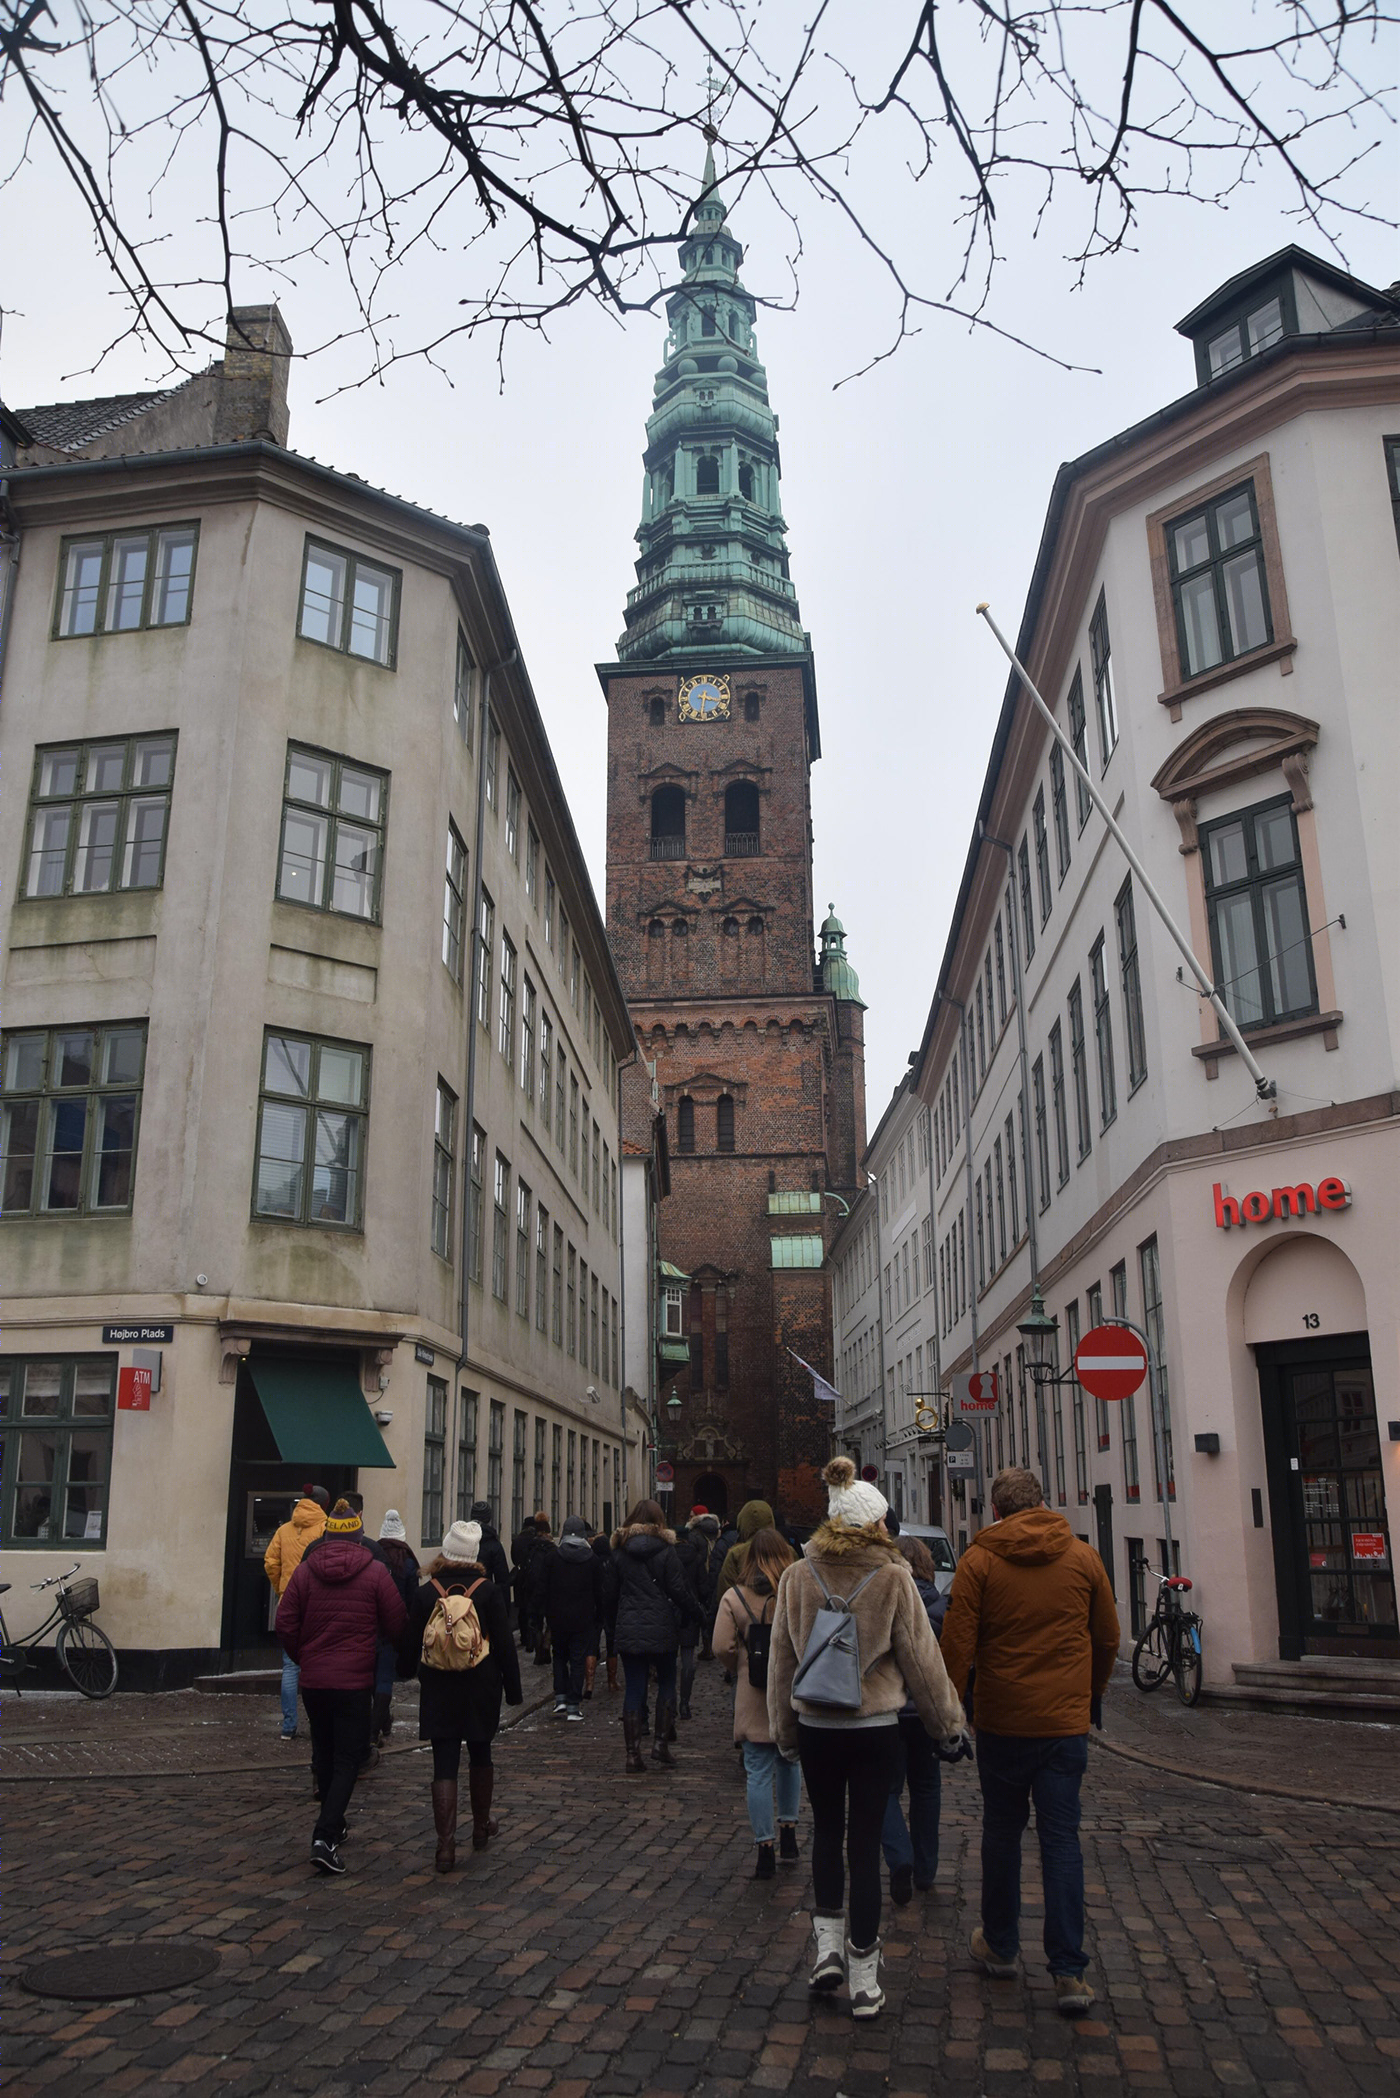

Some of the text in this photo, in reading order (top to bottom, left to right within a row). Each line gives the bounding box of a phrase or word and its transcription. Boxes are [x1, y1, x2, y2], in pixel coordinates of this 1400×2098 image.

[1212, 1177, 1350, 1228] home
[1302, 1313, 1320, 1329] 13
[110, 1328, 165, 1340] Højbro Plads
[133, 1370, 151, 1385] ATM
[960, 1399, 996, 1411] home
